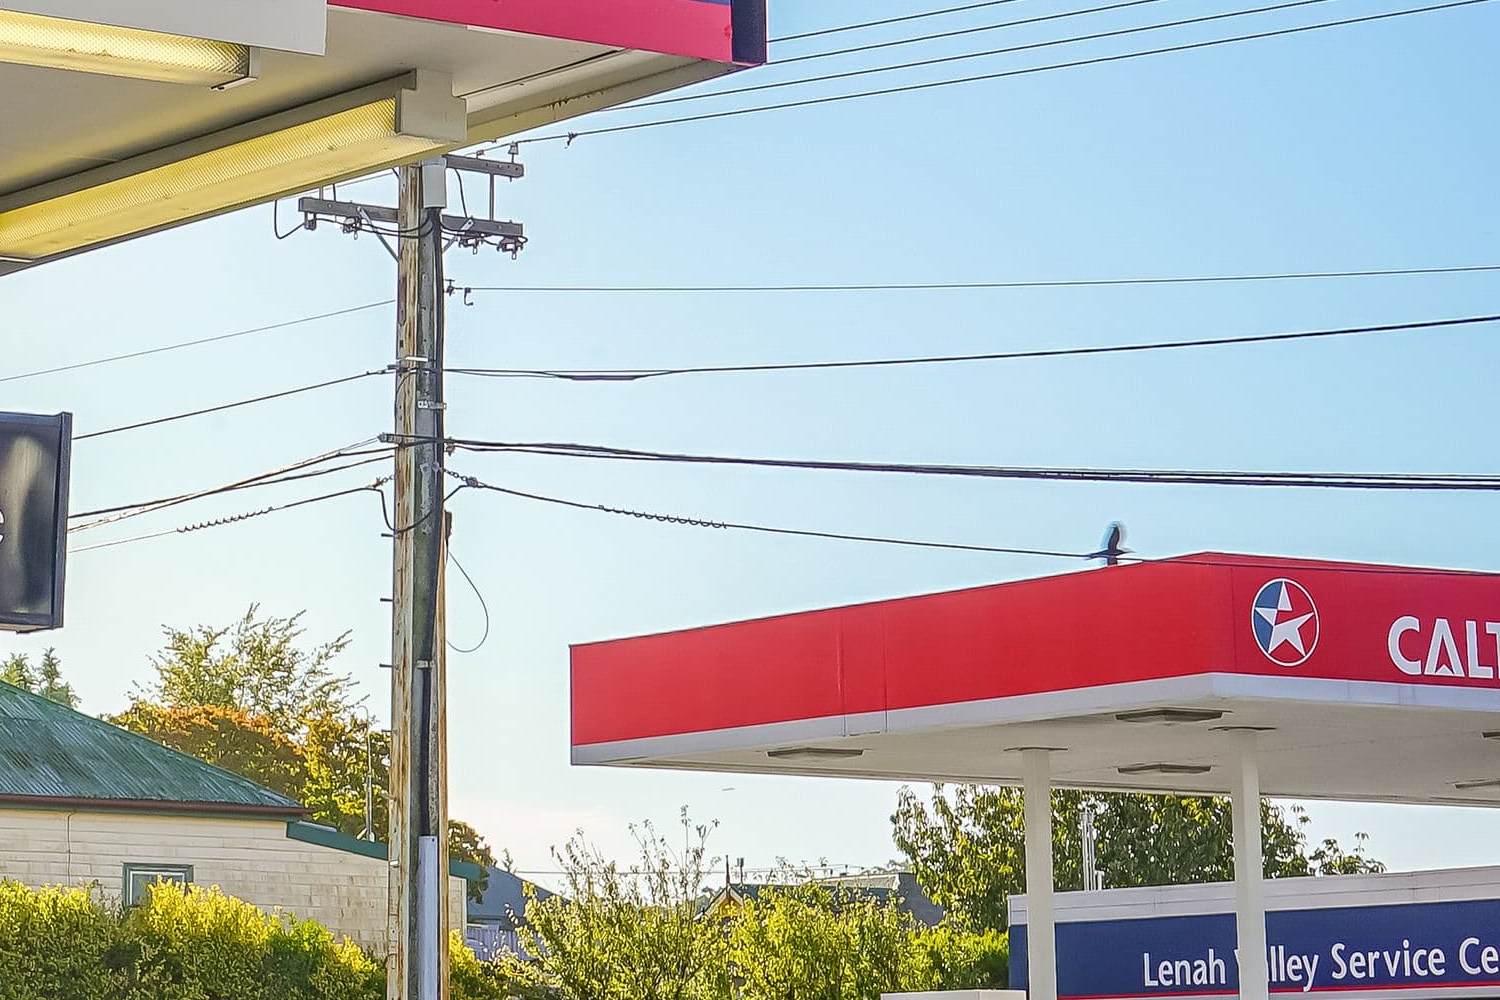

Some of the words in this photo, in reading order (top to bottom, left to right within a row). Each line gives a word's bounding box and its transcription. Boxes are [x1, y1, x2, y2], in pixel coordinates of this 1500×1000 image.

[1143, 948, 1227, 988] Lenah
[1234, 945, 1319, 992] lley
[1331, 939, 1446, 980] Service
